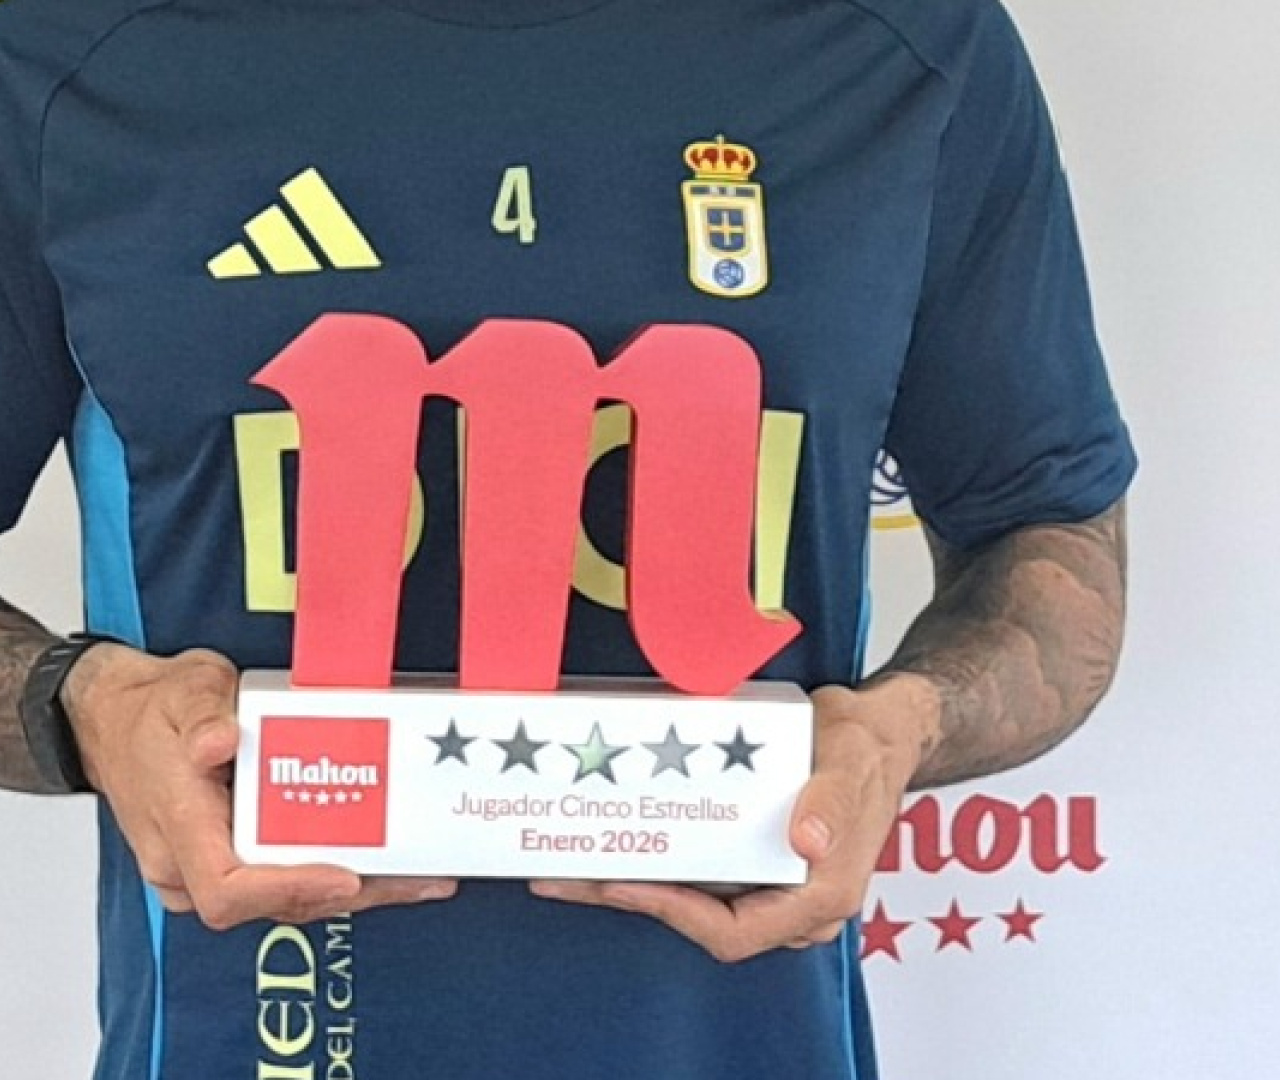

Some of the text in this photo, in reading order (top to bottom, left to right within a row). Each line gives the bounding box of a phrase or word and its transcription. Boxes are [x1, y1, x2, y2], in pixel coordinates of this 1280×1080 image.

[490, 165, 536, 243] 4
[269, 755, 378, 787] Mahou
[451, 791, 740, 822] Jugador Cinco Estrellas
[520, 828, 669, 854] Enero 2026
